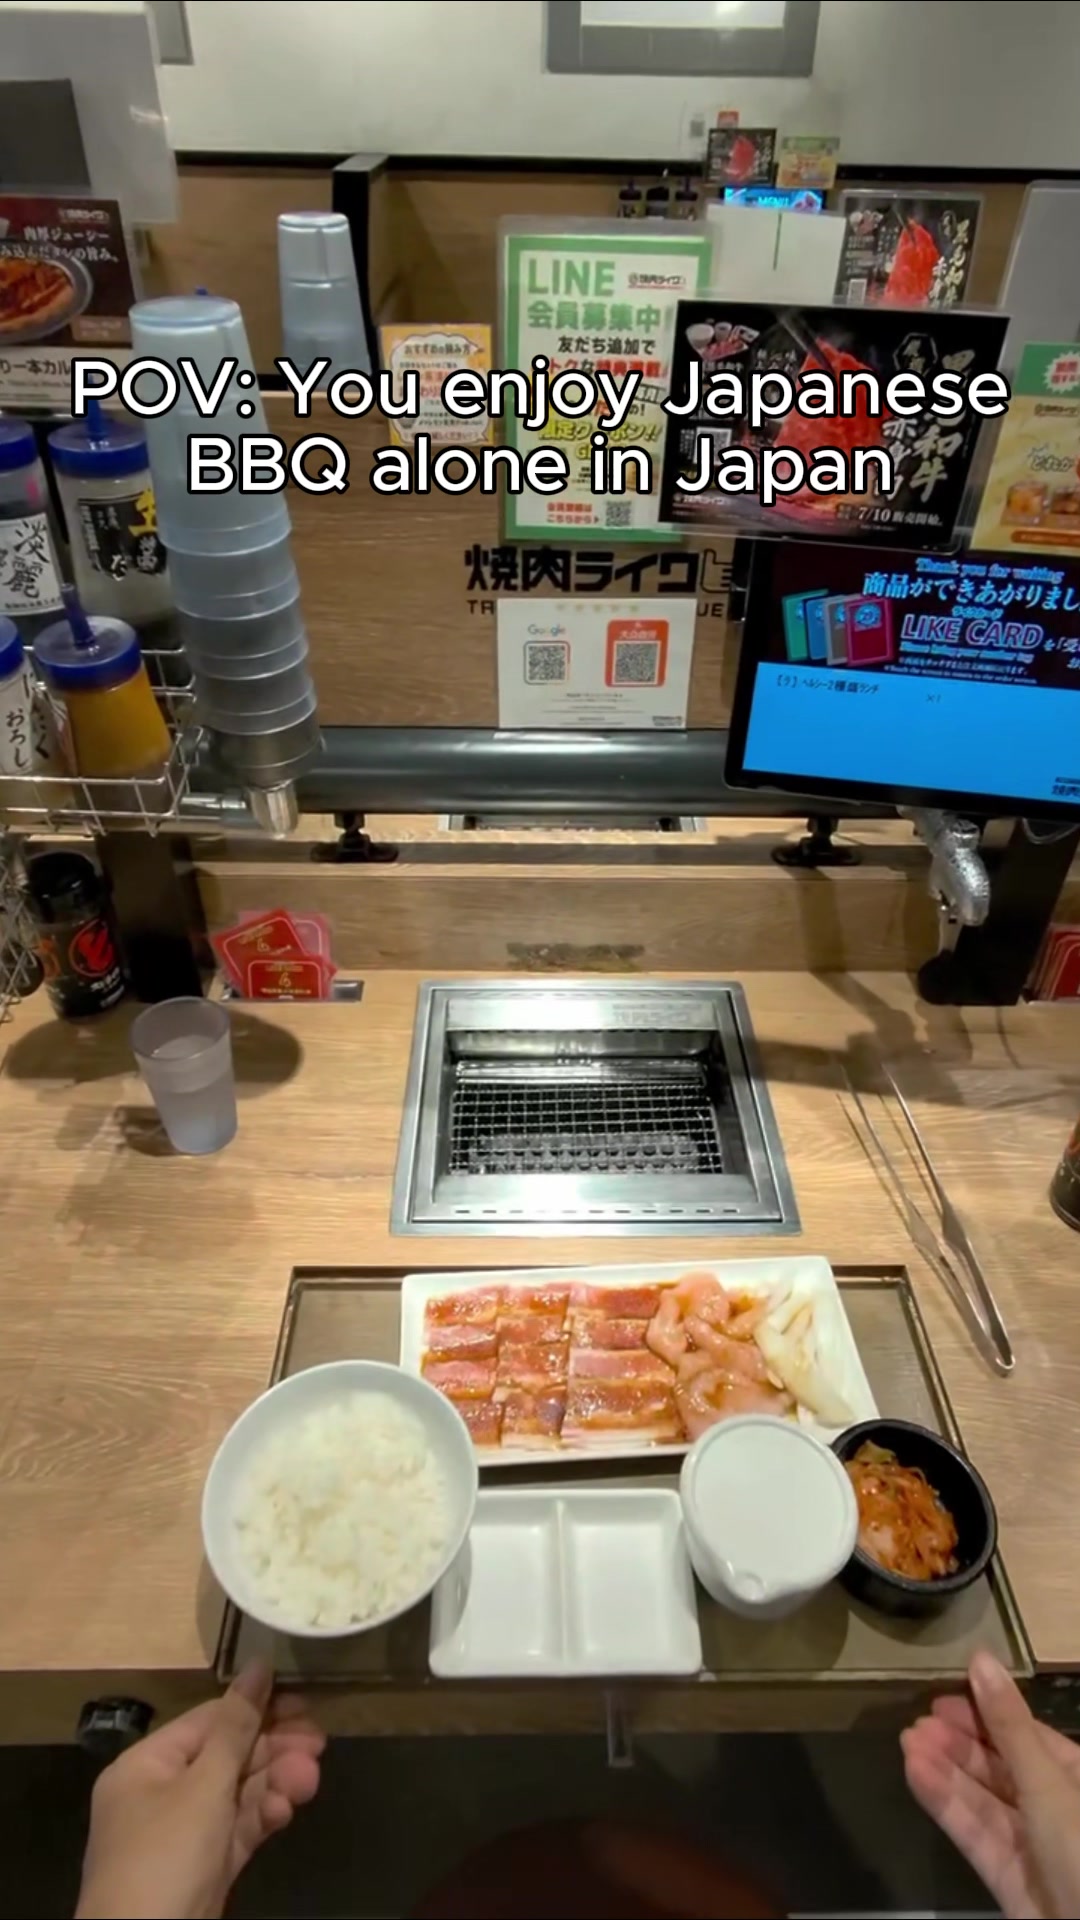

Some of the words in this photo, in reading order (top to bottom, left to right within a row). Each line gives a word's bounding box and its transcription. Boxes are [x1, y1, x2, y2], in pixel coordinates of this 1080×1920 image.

[528, 258, 615, 297] LINE
[557, 335, 656, 355] 友だち追加で
[464, 544, 699, 593] 焼肉ライク
[916, 557, 960, 574] Thank
[961, 563, 987, 578] you
[988, 563, 1011, 578] for
[1012, 565, 1065, 584] waiting
[527, 623, 566, 637] Google
[900, 614, 963, 643] LIKE
[965, 619, 1044, 649] CARD
[6, 707, 28, 768] おろし
